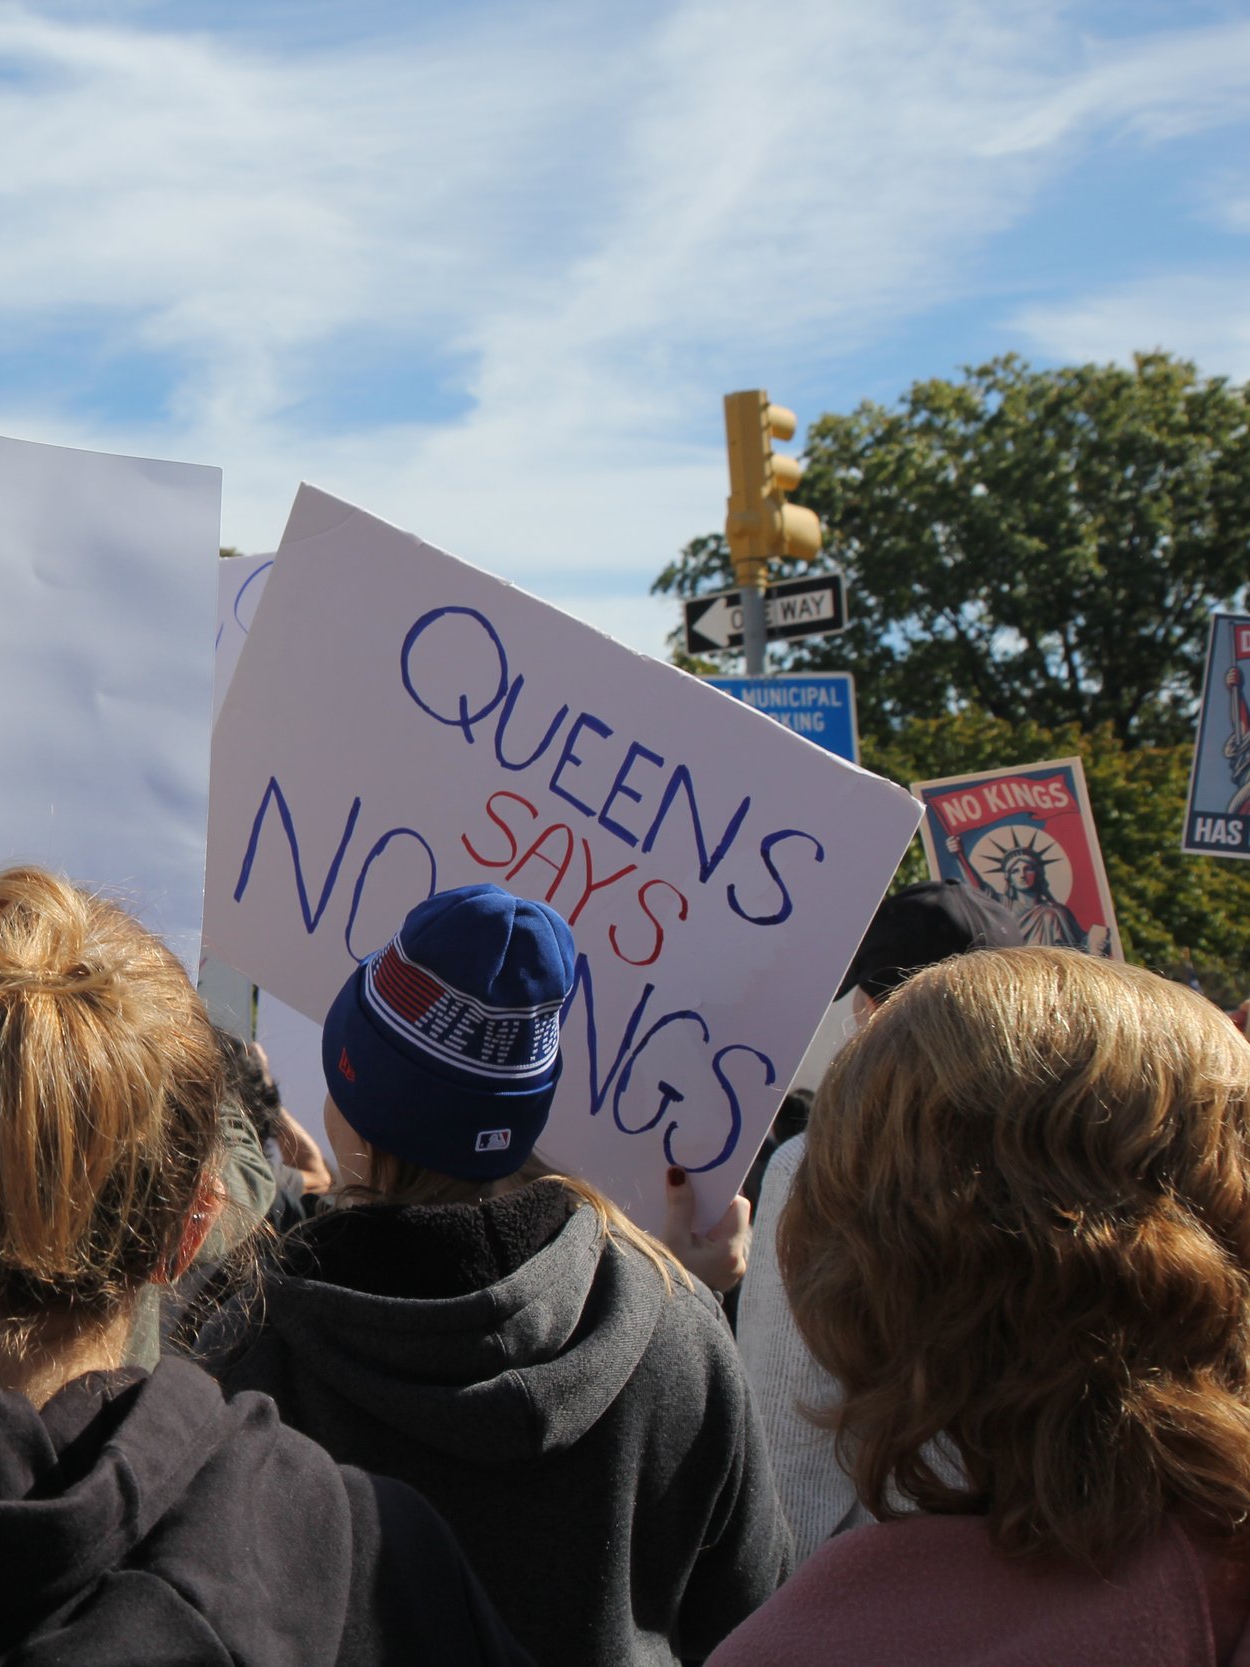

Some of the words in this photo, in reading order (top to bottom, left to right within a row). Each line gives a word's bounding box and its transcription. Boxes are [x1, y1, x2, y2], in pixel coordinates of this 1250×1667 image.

[780, 594, 825, 622] WAY
[741, 686, 843, 708] MUNICIPAL
[400, 606, 825, 926] QUEENS
[941, 794, 982, 827] NO
[981, 782, 1069, 813] KINGS
[233, 776, 437, 964] NO
[461, 791, 688, 966] SAYS
[1194, 817, 1243, 846] HAS
[558, 953, 776, 1173] NGS
